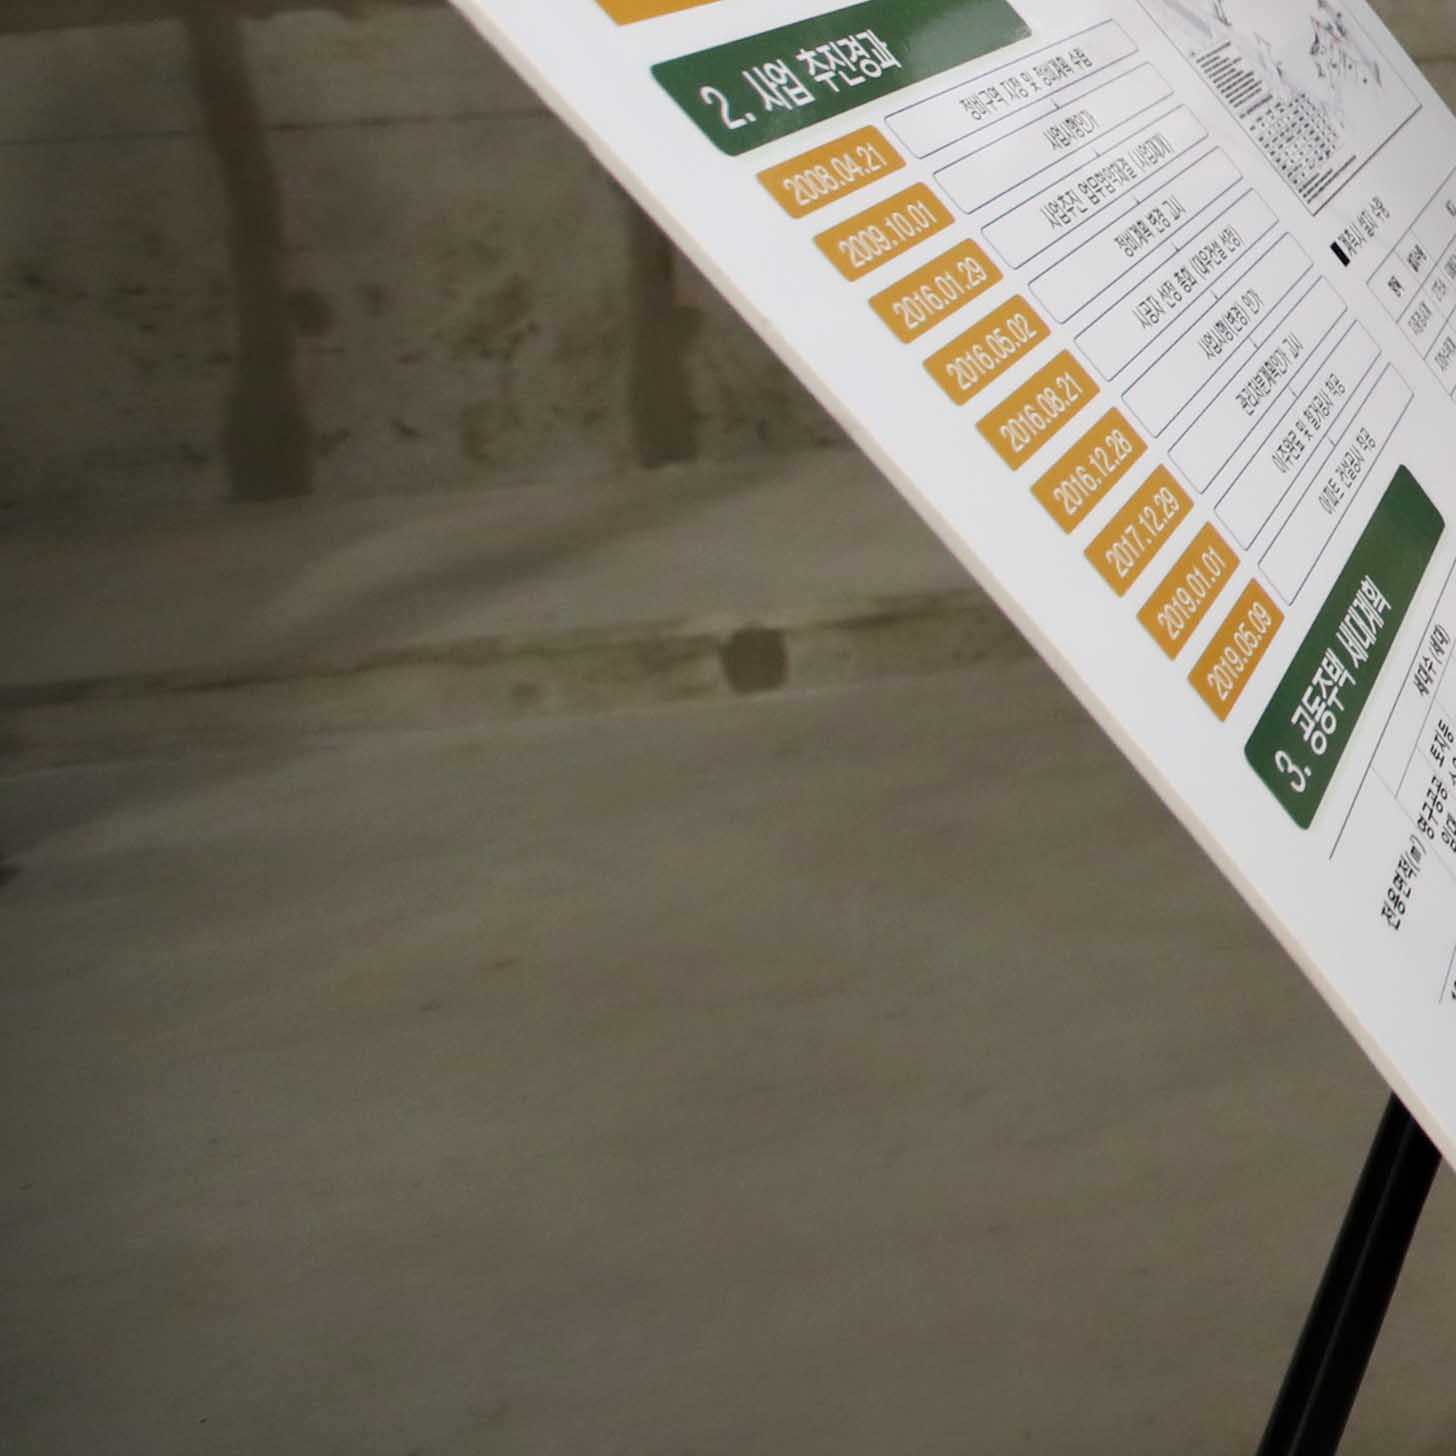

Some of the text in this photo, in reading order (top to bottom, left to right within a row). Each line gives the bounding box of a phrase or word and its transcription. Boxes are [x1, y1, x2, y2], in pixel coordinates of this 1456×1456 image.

[698, 28, 902, 130] 2. 사업 추진경과
[782, 142, 887, 206] 2008.04.21
[1041, 190, 1088, 228] 사업추진
[837, 199, 937, 268] 2009.10.01
[1113, 219, 1153, 257] 정비계획
[1146, 207, 1171, 233] 변경
[891, 255, 987, 329] 2016.01.29
[1134, 295, 1165, 328] 시공자
[1157, 279, 1182, 308] 선정
[1218, 226, 1243, 253] 선정)
[944, 311, 1037, 391] 2016.05.02
[998, 370, 1083, 453] 2016.08.21
[1052, 427, 1133, 516] 2016.12.28
[1317, 426, 1376, 514] 아파트 건설공사 착공
[1104, 485, 1180, 578] 2017.12.29
[1156, 544, 1226, 641] 2019.01.01
[1206, 600, 1272, 701] 2019.05.09
[1274, 574, 1392, 792] 3. 공동주택 세대계획
[1413, 624, 1450, 696] 세대수 (세대)
[1429, 719, 1454, 767] 토지등
[1416, 775, 1448, 839] 영구공공
